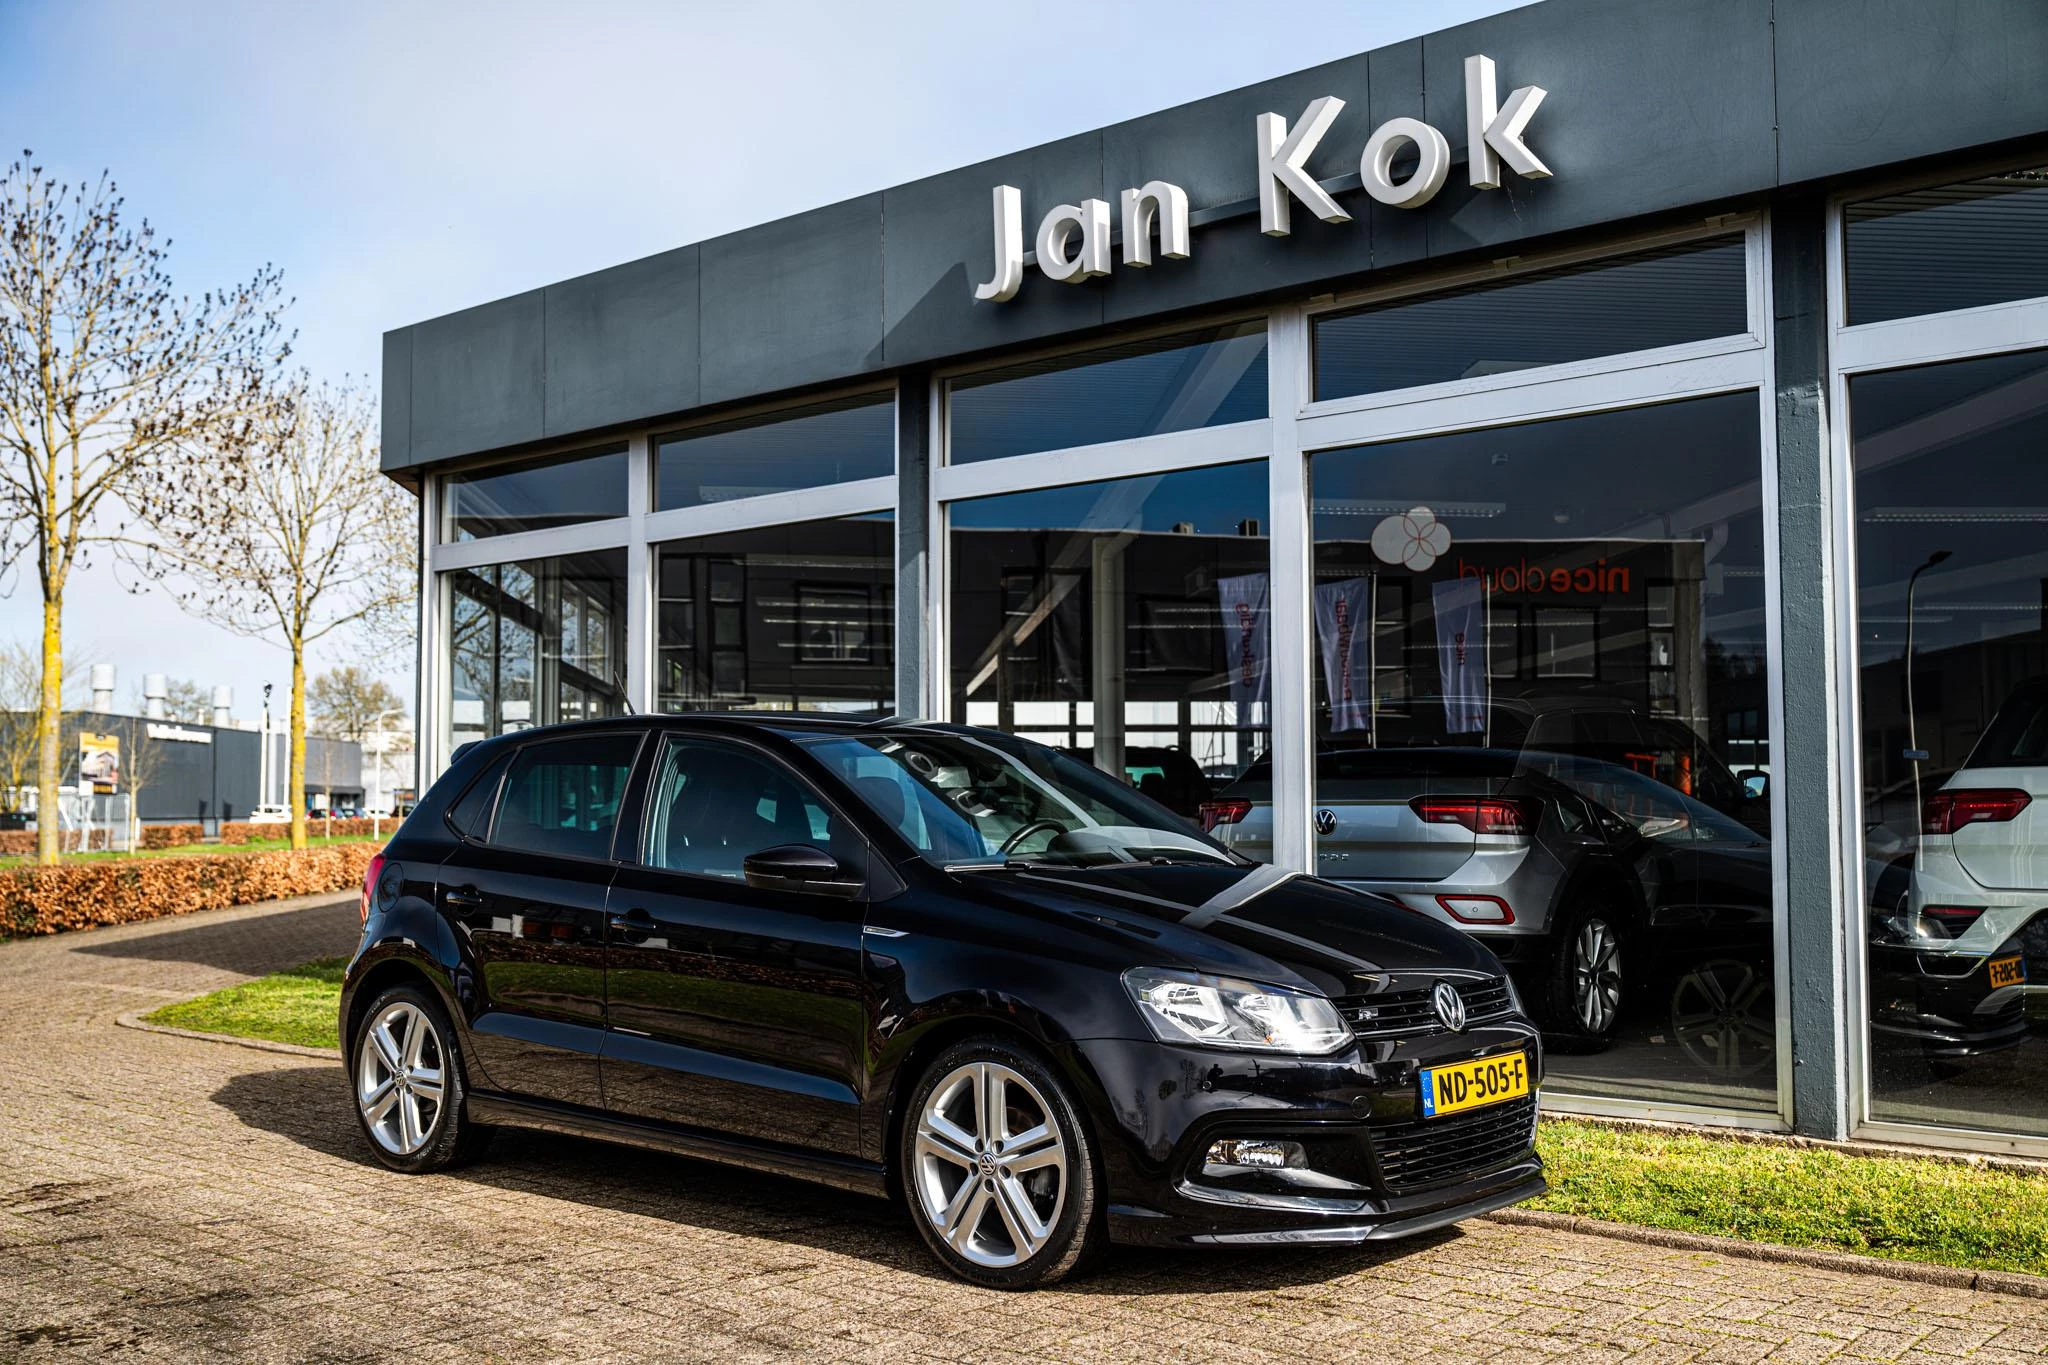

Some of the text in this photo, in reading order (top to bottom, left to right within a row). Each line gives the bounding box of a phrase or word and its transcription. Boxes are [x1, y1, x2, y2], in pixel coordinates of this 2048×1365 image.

[974, 54, 1553, 303] Jan Kok
[1424, 1099, 1433, 1109] NL
[1438, 1058, 1524, 1106] ND-505-F
